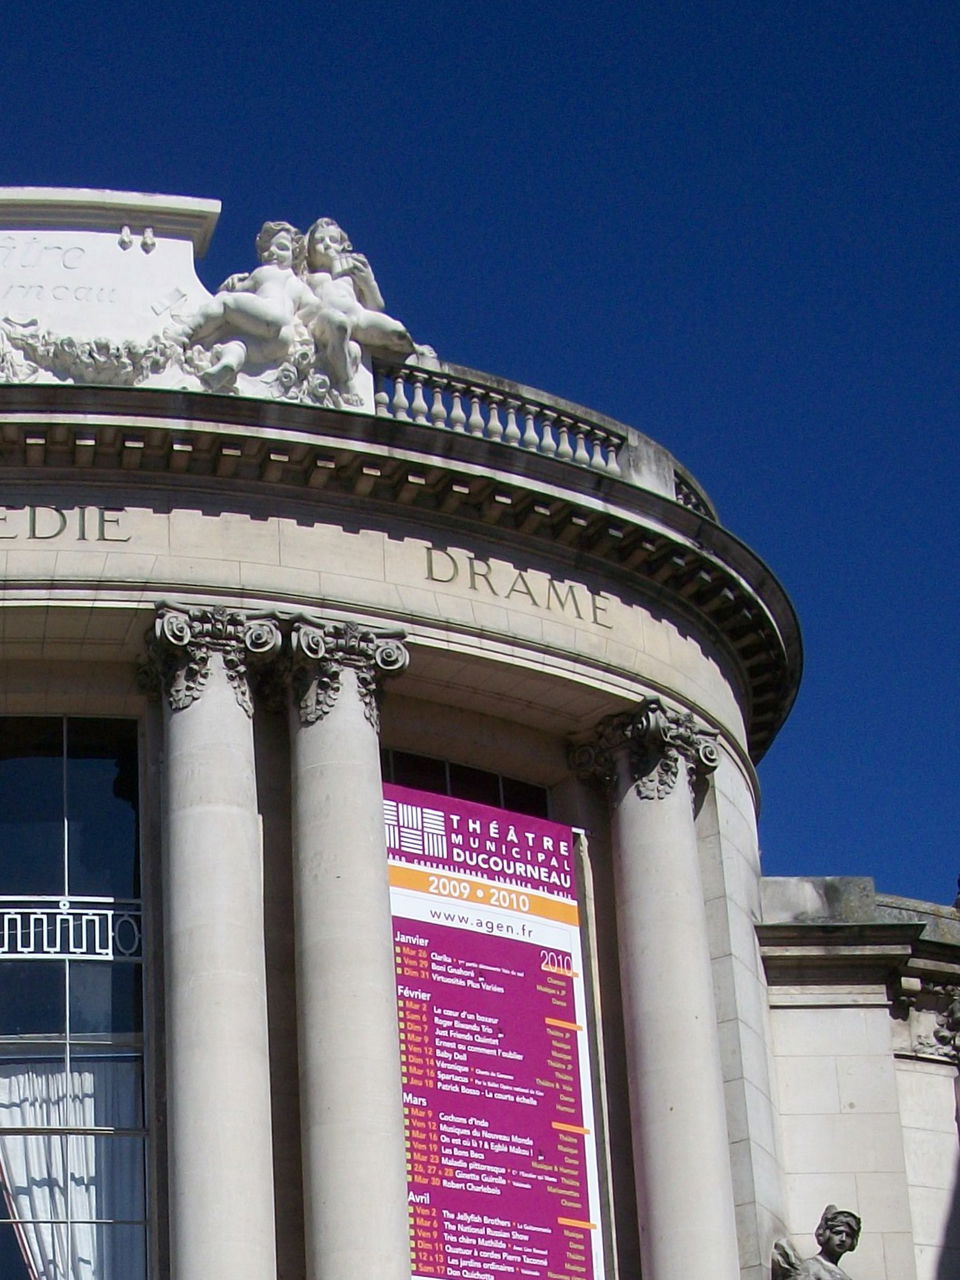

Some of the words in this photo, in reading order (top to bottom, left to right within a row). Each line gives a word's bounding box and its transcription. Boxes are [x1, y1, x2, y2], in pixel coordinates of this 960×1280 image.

[424, 545, 614, 630] DRAME
[450, 814, 569, 856] THÉÂTRE
[451, 833, 570, 872] MUNICIPAL
[452, 848, 571, 888] DUCOURNEAU
[428, 876, 470, 899] 2009
[490, 888, 530, 912] 2010
[430, 908, 534, 938] www.agen.fr
[394, 930, 429, 948] Janvier
[539, 949, 572, 976] 2010
[420, 970, 429, 979] 31
[397, 985, 431, 1002] Février
[434, 1027, 448, 1037] Just
[449, 1030, 473, 1041] Friends
[481, 1025, 493, 1034] Trio
[424, 1047, 432, 1055] 12
[435, 1048, 452, 1060] Baby
[453, 1051, 466, 1061] Doll
[435, 1038, 456, 1049] Ernest
[467, 1045, 496, 1056] comment
[435, 1059, 469, 1074] Véronique
[436, 1071, 469, 1085] Spartacus
[437, 1081, 459, 1092] Patrick
[485, 1090, 492, 1098] La
[402, 1091, 427, 1107] Mars
[438, 1112, 466, 1124] Cochons
[427, 1121, 436, 1130] 12
[471, 1128, 480, 1137] du
[511, 1135, 533, 1146] Monde
[440, 1134, 450, 1143] On
[441, 1145, 452, 1154] Les
[428, 1155, 438, 1163] 23
[427, 1165, 436, 1174] 27
[429, 1177, 440, 1186] 30
[442, 1179, 464, 1190] Robert
[465, 1182, 500, 1195] Charlebois
[407, 1189, 430, 1204] Avril
[442, 1209, 454, 1219] The
[455, 1211, 482, 1225] Jellyfish
[483, 1215, 510, 1227] Brothers
[443, 1221, 456, 1230] The
[457, 1223, 485, 1235] National
[486, 1227, 510, 1238] Russian
[511, 1231, 529, 1241] Show
[443, 1232, 457, 1242] Très
[458, 1234, 476, 1245] chère
[477, 1237, 506, 1249] Mathilde
[417, 1240, 432, 1249] Dim
[435, 1242, 443, 1251] 11
[444, 1244, 472, 1255] Quatuor
[479, 1249, 500, 1259] cordes
[501, 1252, 521, 1262] Pierre
[418, 1252, 427, 1260] 12
[435, 1254, 443, 1262] 13
[447, 1256, 458, 1265] Les
[459, 1257, 481, 1269] jardins
[482, 1261, 514, 1273] ordinaires
[435, 1265, 445, 1274] 17
[446, 1267, 460, 1276] Don
[461, 1268, 494, 1280] Quichotte
